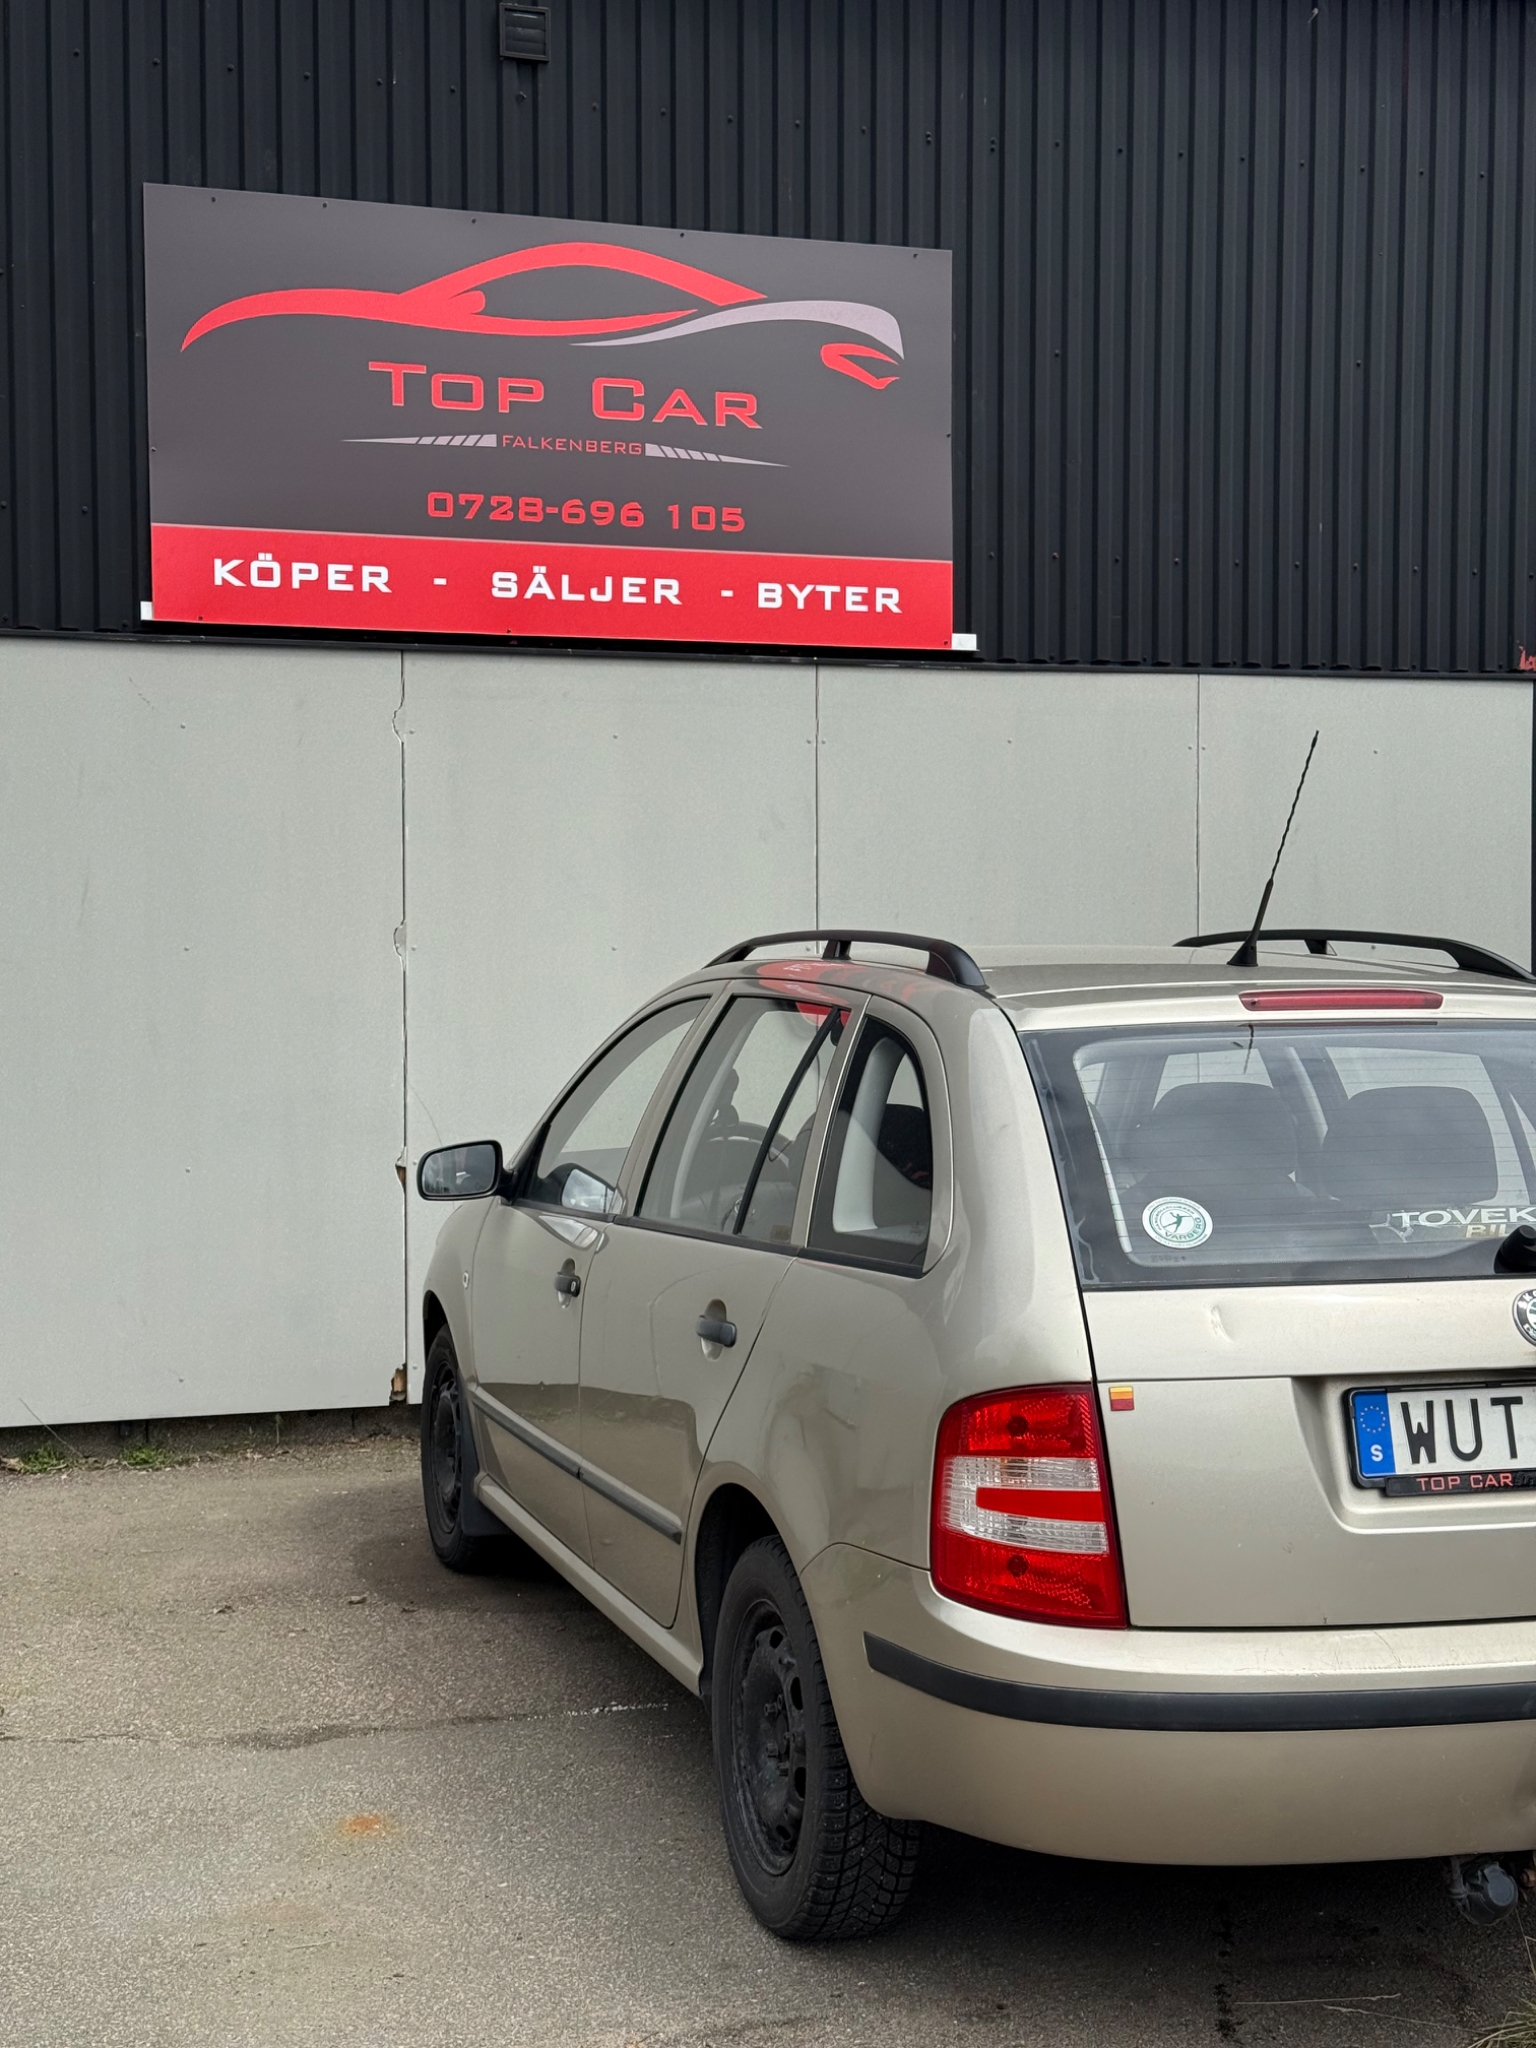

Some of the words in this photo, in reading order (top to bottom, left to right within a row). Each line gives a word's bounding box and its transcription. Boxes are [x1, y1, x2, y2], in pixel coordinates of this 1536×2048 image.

[501, 434, 643, 456] FALKENBERG
[426, 490, 646, 529] 0728-696
[667, 503, 747, 533] 105
[213, 552, 393, 594] KÖPER
[491, 565, 683, 606] SÄLJER
[757, 582, 903, 614] BYTER
[1400, 1395, 1524, 1465] WUT
[1370, 1444, 1384, 1462] S
[1416, 1475, 1461, 1492] TOP
[1470, 1472, 1514, 1489] CAR
